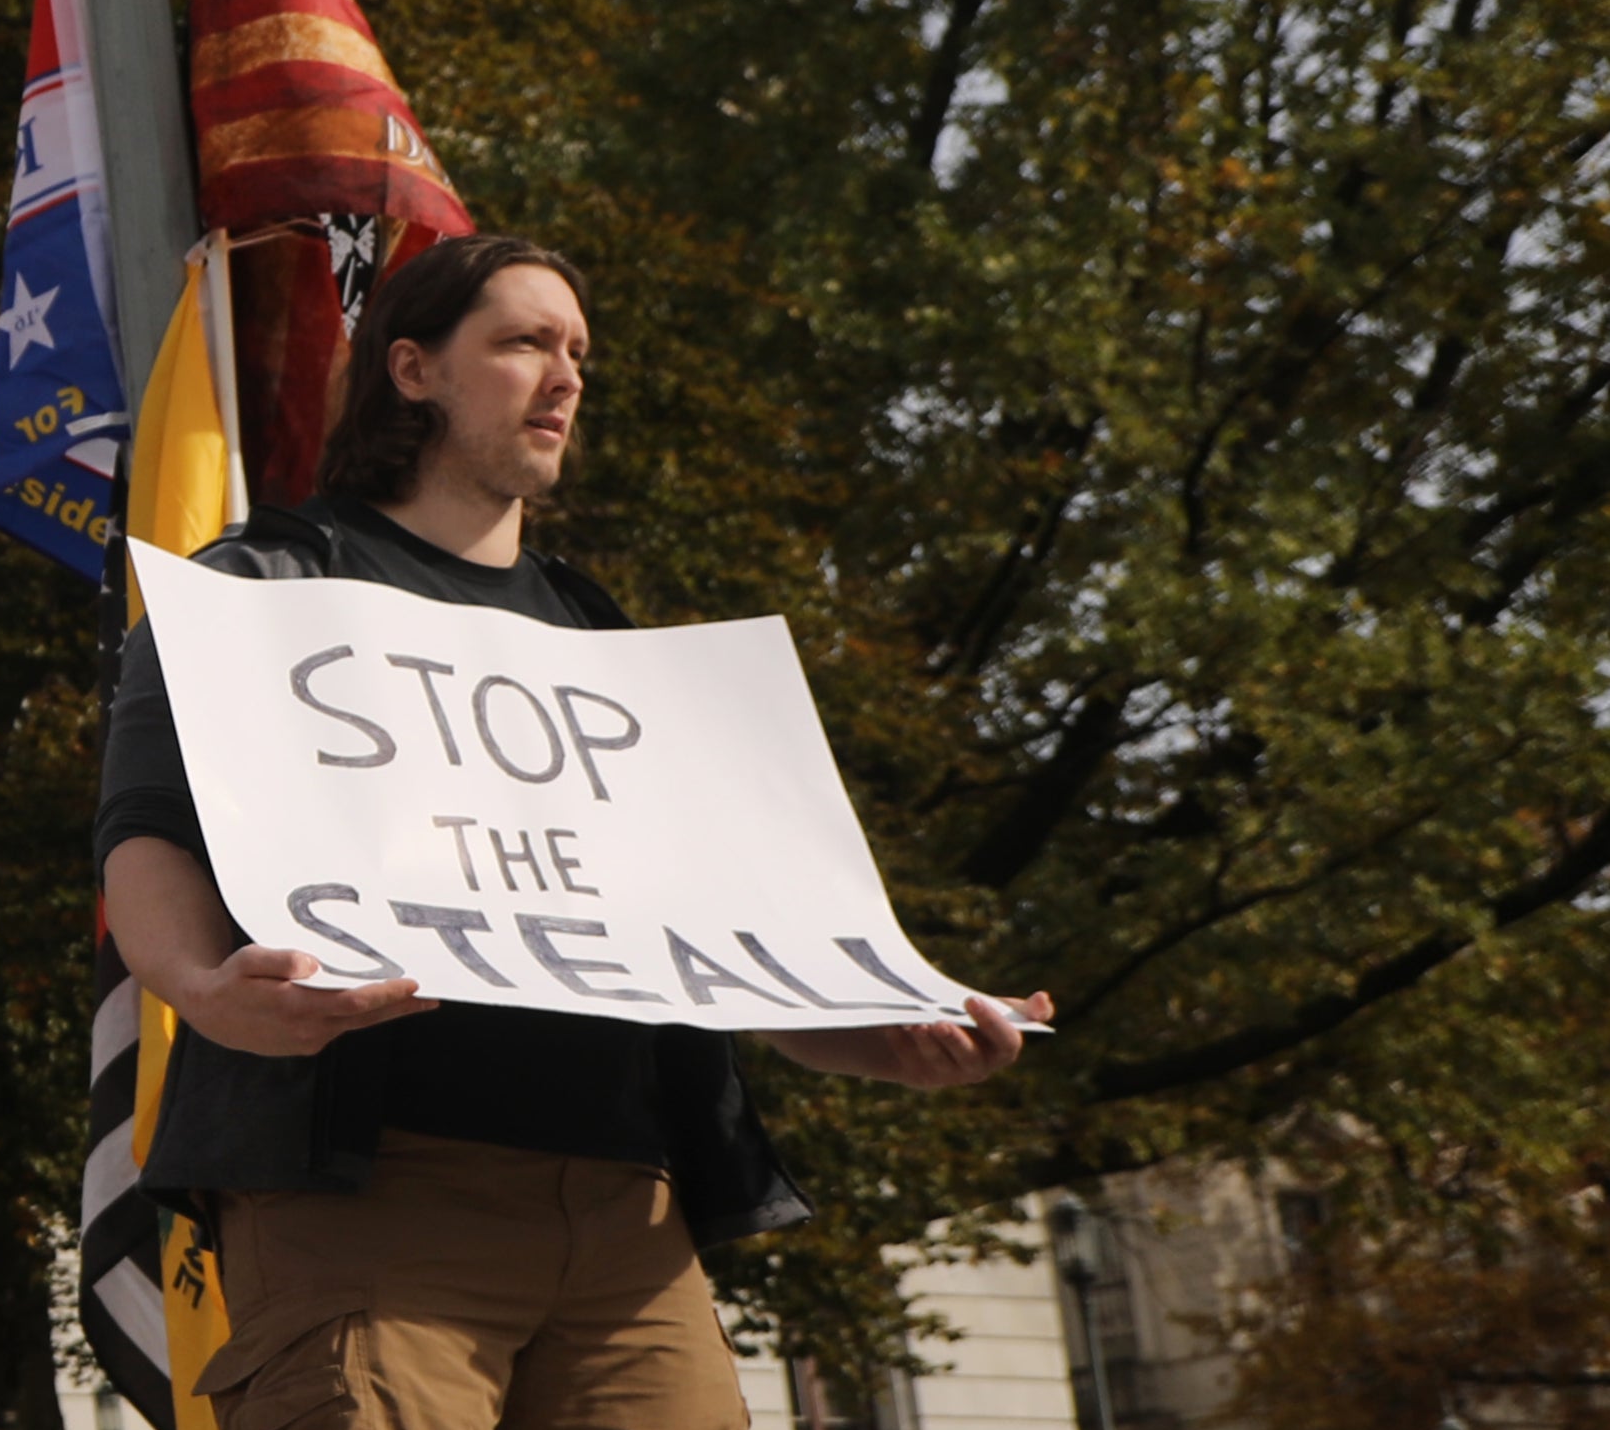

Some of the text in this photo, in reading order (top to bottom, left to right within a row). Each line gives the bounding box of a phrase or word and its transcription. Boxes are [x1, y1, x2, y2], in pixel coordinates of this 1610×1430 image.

[289, 644, 641, 802] STOP
[432, 815, 601, 898] THE
[286, 882, 967, 1016] STEAL!
